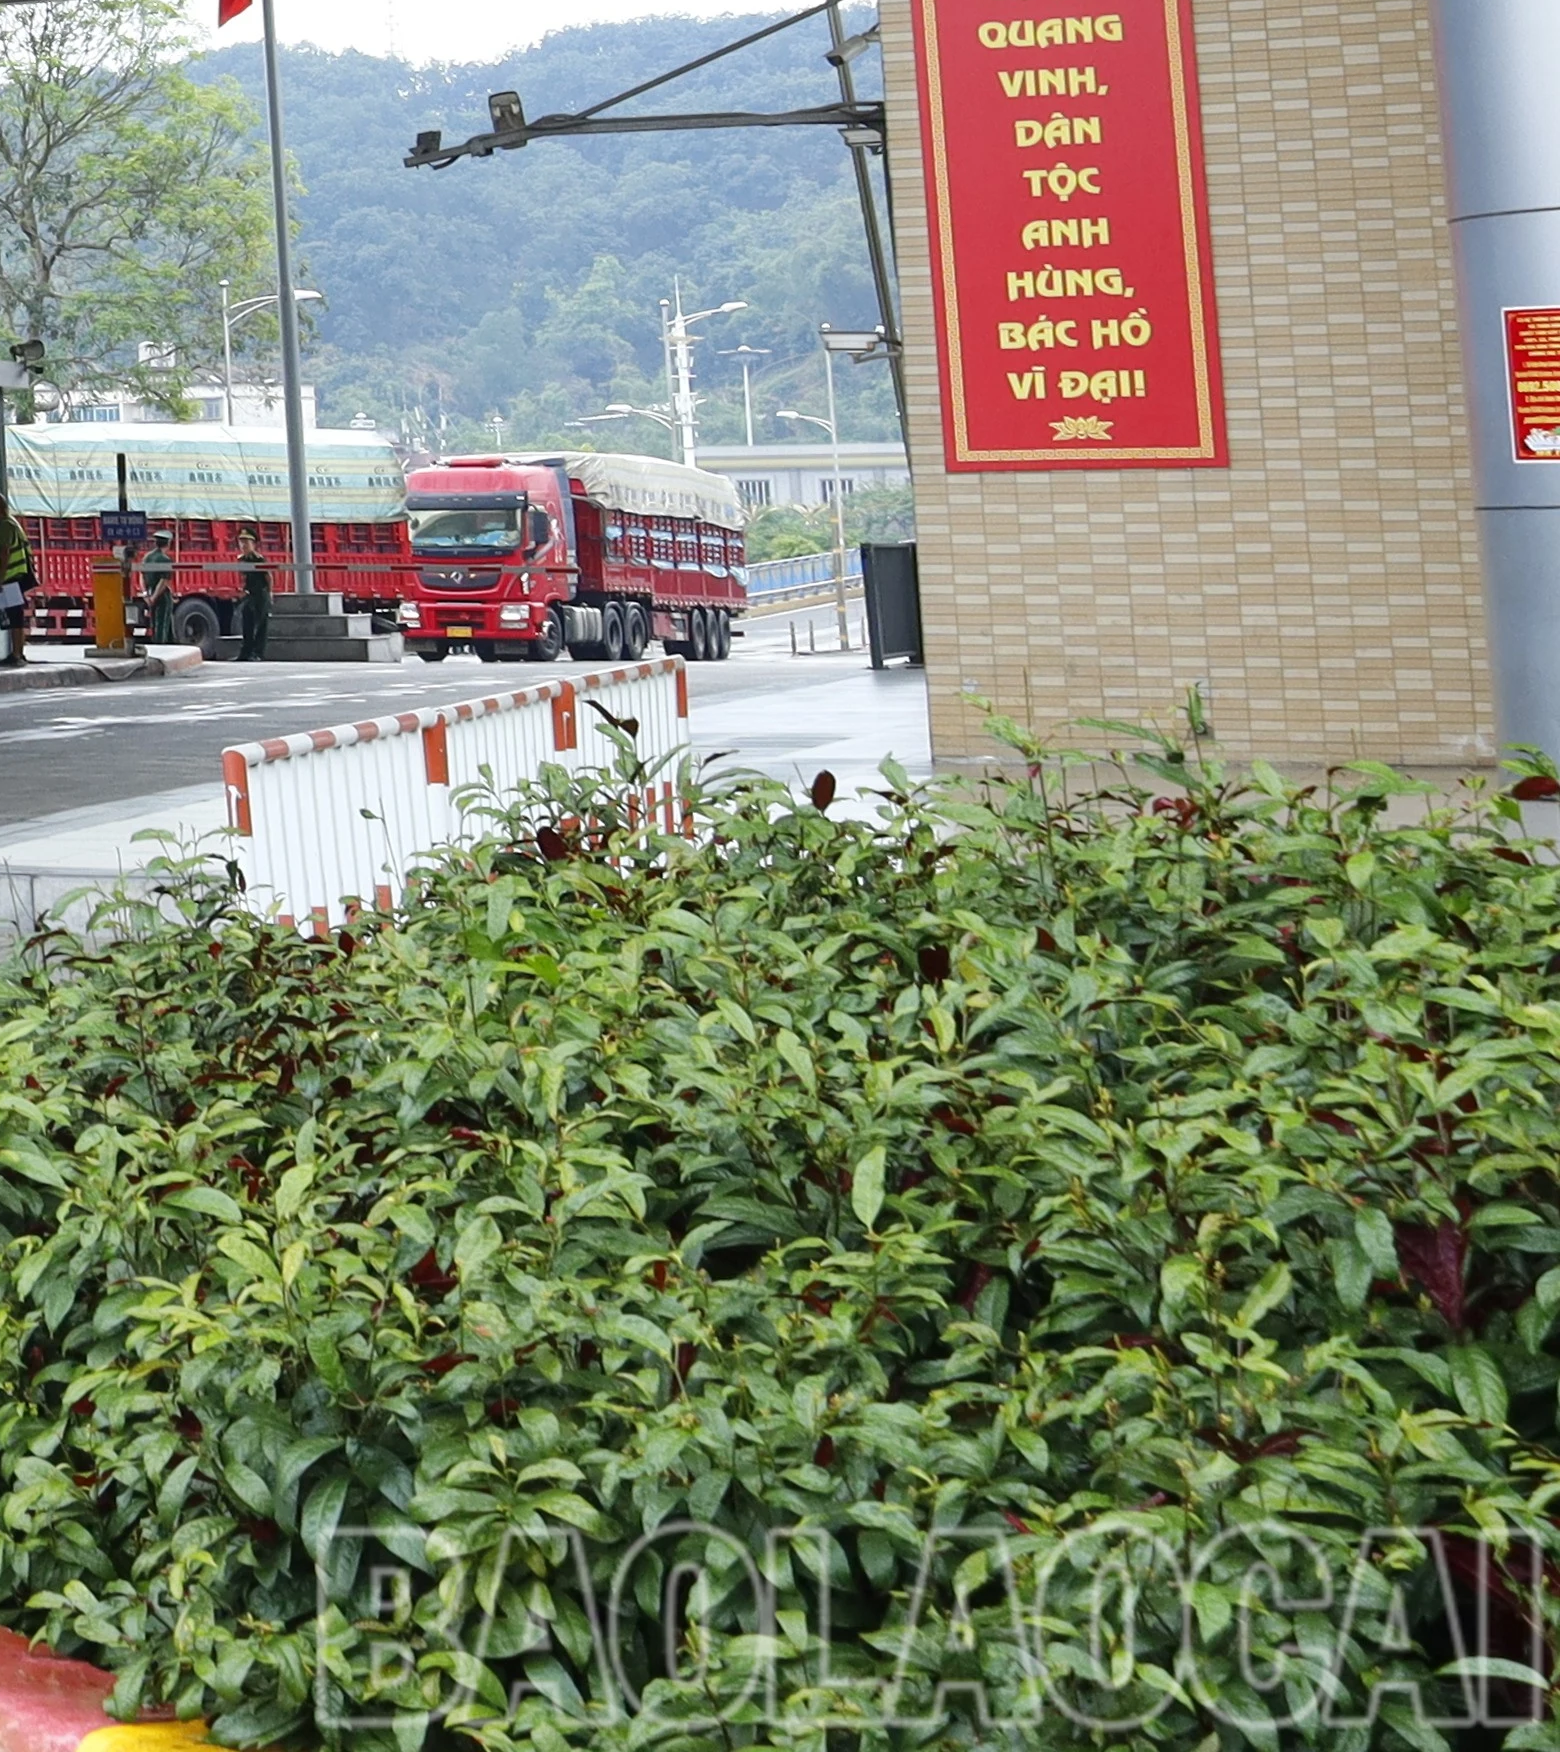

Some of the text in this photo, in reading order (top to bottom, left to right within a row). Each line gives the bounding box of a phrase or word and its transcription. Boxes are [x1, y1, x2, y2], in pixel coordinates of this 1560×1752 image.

[978, 14, 1123, 50] QUANG
[998, 66, 1109, 98] VINH,
[1015, 112, 1102, 149] DÂN
[1023, 163, 1102, 202] TỘC
[1022, 217, 1110, 251] ANH
[1007, 267, 1135, 302] HÙNG,
[998, 307, 1153, 350] BÁC HỒ
[1007, 366, 1147, 404] VĨ ĐẠI!
